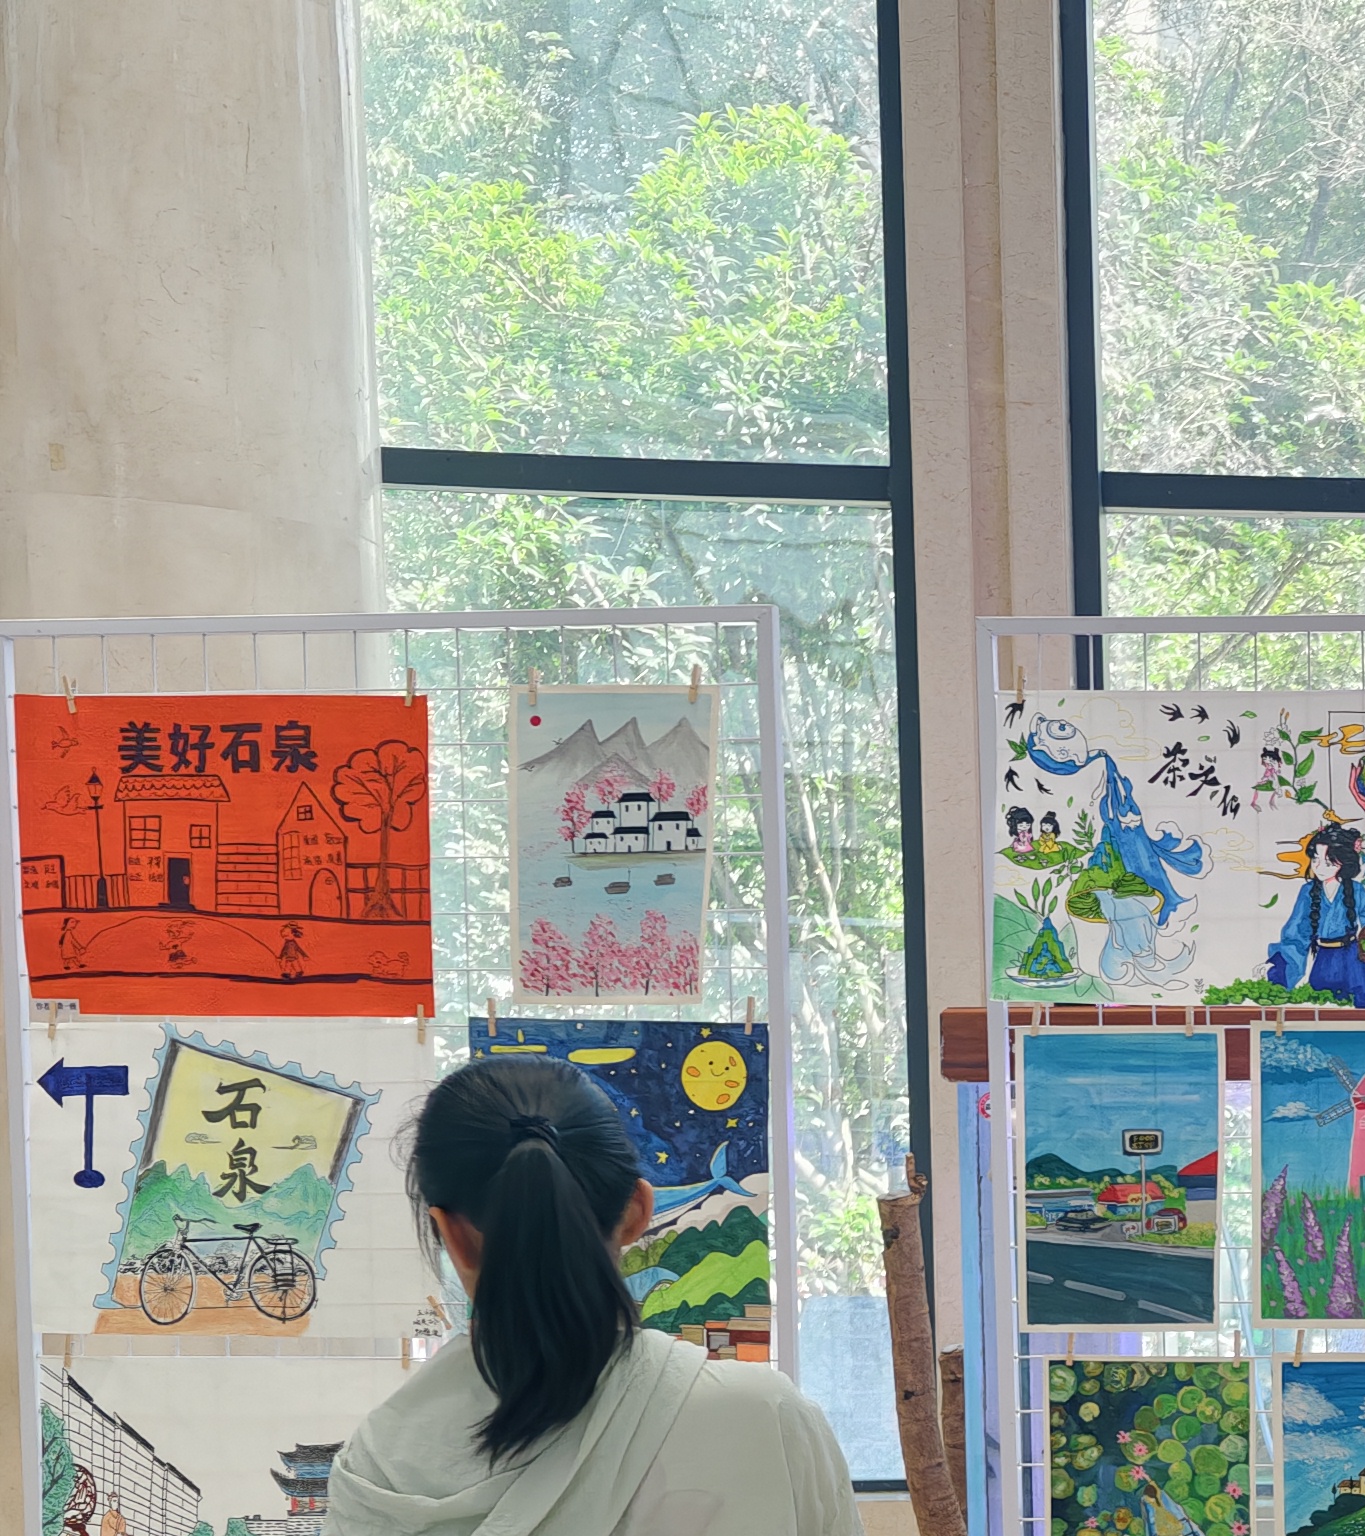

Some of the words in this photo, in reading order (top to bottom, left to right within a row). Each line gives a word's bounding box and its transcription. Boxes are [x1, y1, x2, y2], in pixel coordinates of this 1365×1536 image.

[118, 720, 320, 775] 美好石泉
[201, 1076, 273, 1205] 石泉
